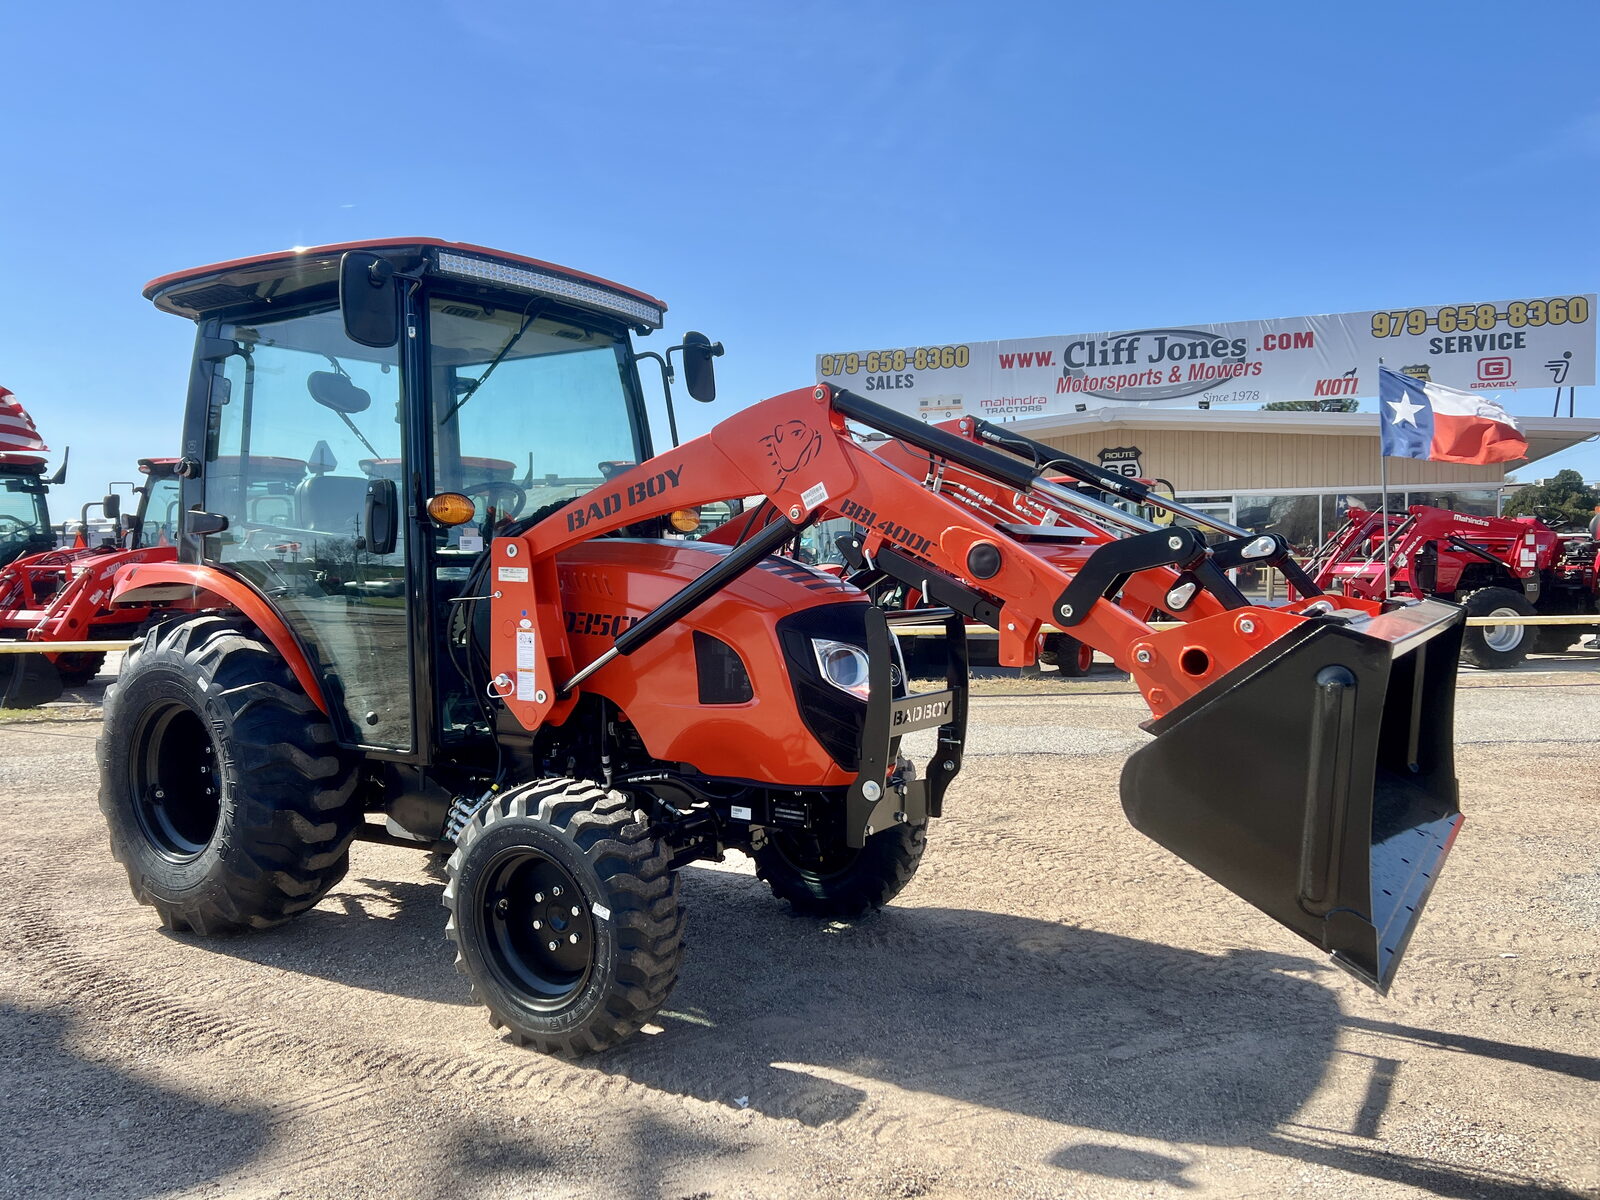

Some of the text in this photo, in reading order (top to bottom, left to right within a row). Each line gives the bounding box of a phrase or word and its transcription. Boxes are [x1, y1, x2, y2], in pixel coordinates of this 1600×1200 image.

[1371, 296, 1589, 338] 979-658-8360
[1064, 336, 1141, 368] Cliff
[1148, 336, 1247, 363] Jones
[1256, 331, 1314, 352] .COM
[1429, 332, 1526, 355] SERVICE
[821, 346, 970, 376] 979-658-8360
[865, 374, 914, 391] SALES
[1056, 361, 1263, 394] Motorsports & Mowers
[1314, 377, 1358, 396] KIOTI
[1470, 381, 1517, 389] GRAVELY
[980, 395, 1047, 407] mahindra
[1203, 390, 1260, 402] Since 1978
[985, 405, 1042, 414] TRACTORS
[1104, 451, 1136, 459] ROUTE
[566, 464, 684, 532] BAD BOY
[840, 498, 938, 557] BBL400C
[1453, 513, 1490, 527] Mahindra
